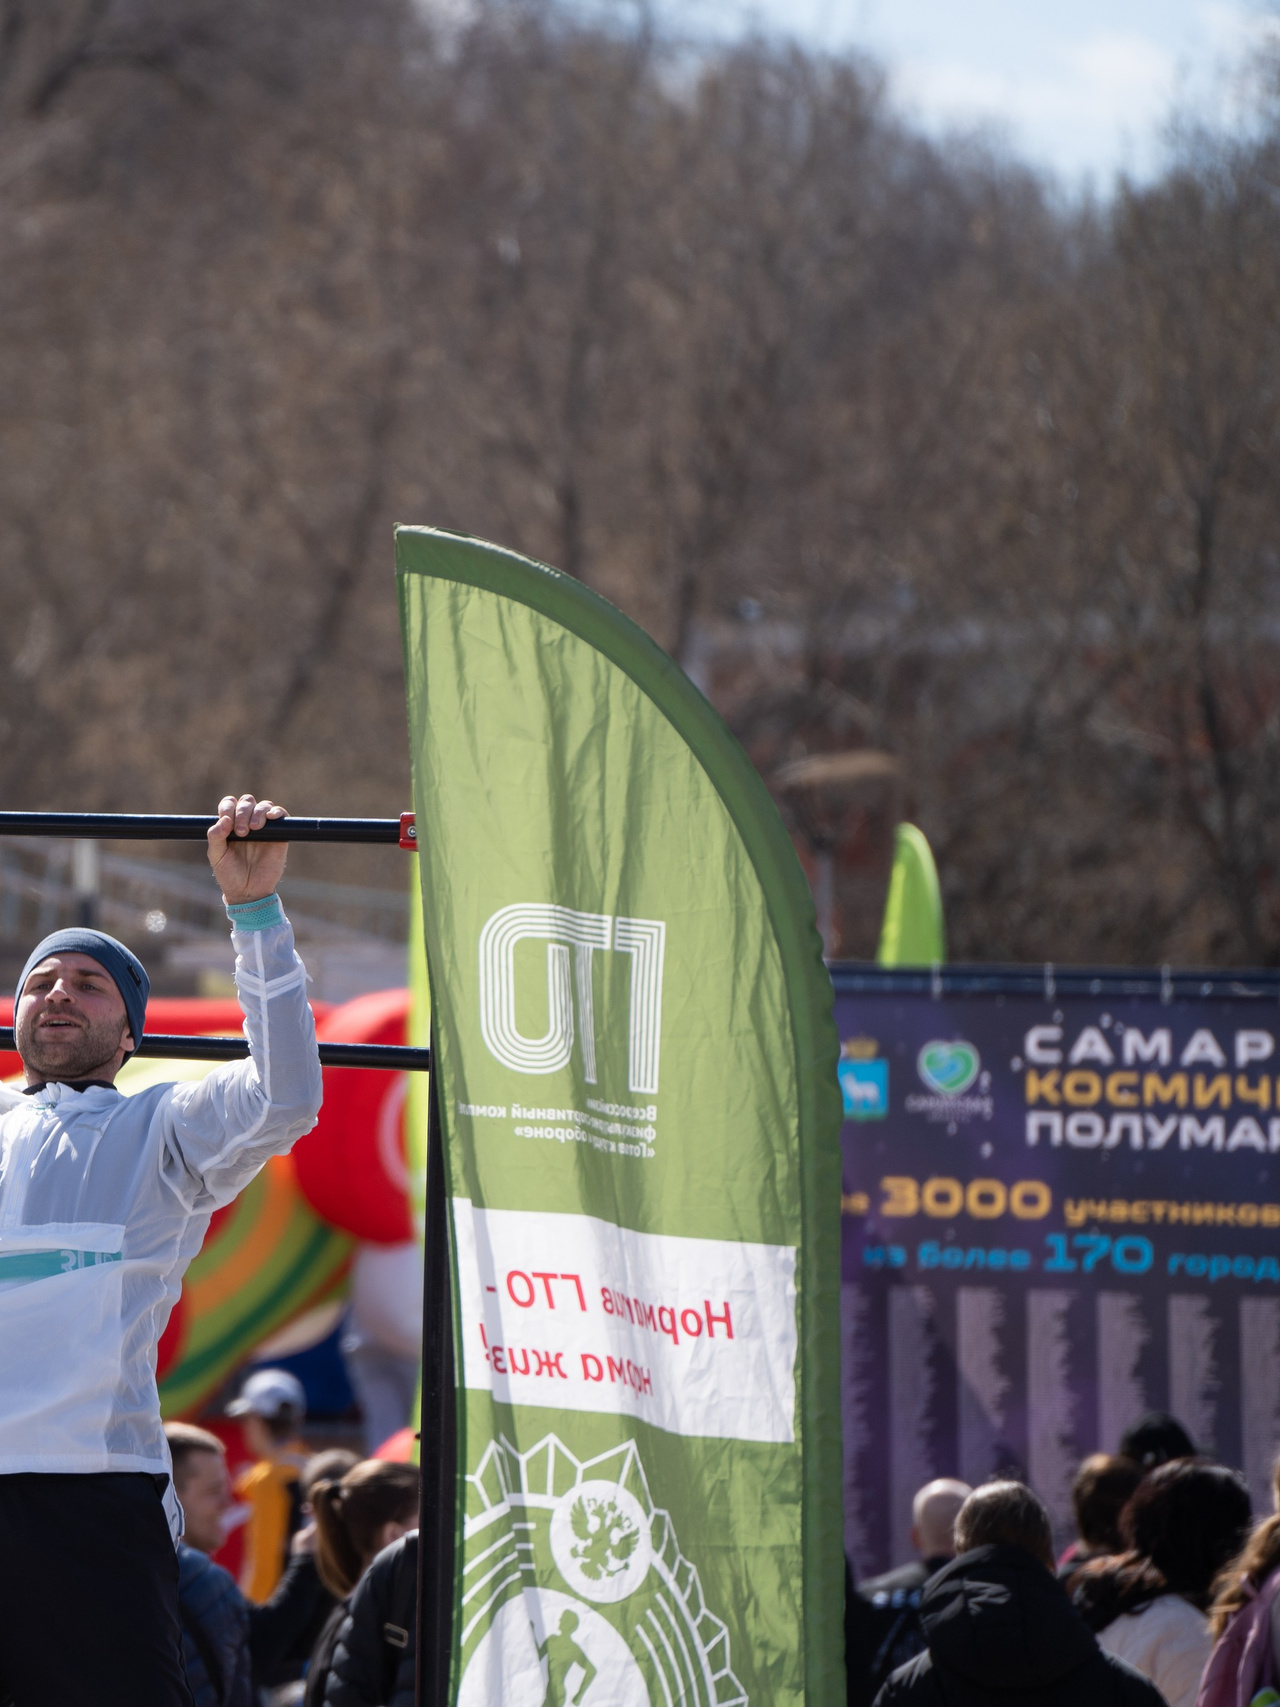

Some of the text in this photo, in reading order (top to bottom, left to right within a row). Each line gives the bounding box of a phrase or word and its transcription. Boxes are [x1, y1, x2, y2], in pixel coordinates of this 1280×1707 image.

[1024, 1025, 1275, 1068] САМАР
[1025, 1069, 1280, 1110] КОСМИЧ
[880, 1176, 1052, 1220] 3000
[1044, 1233, 1154, 1274] 170
